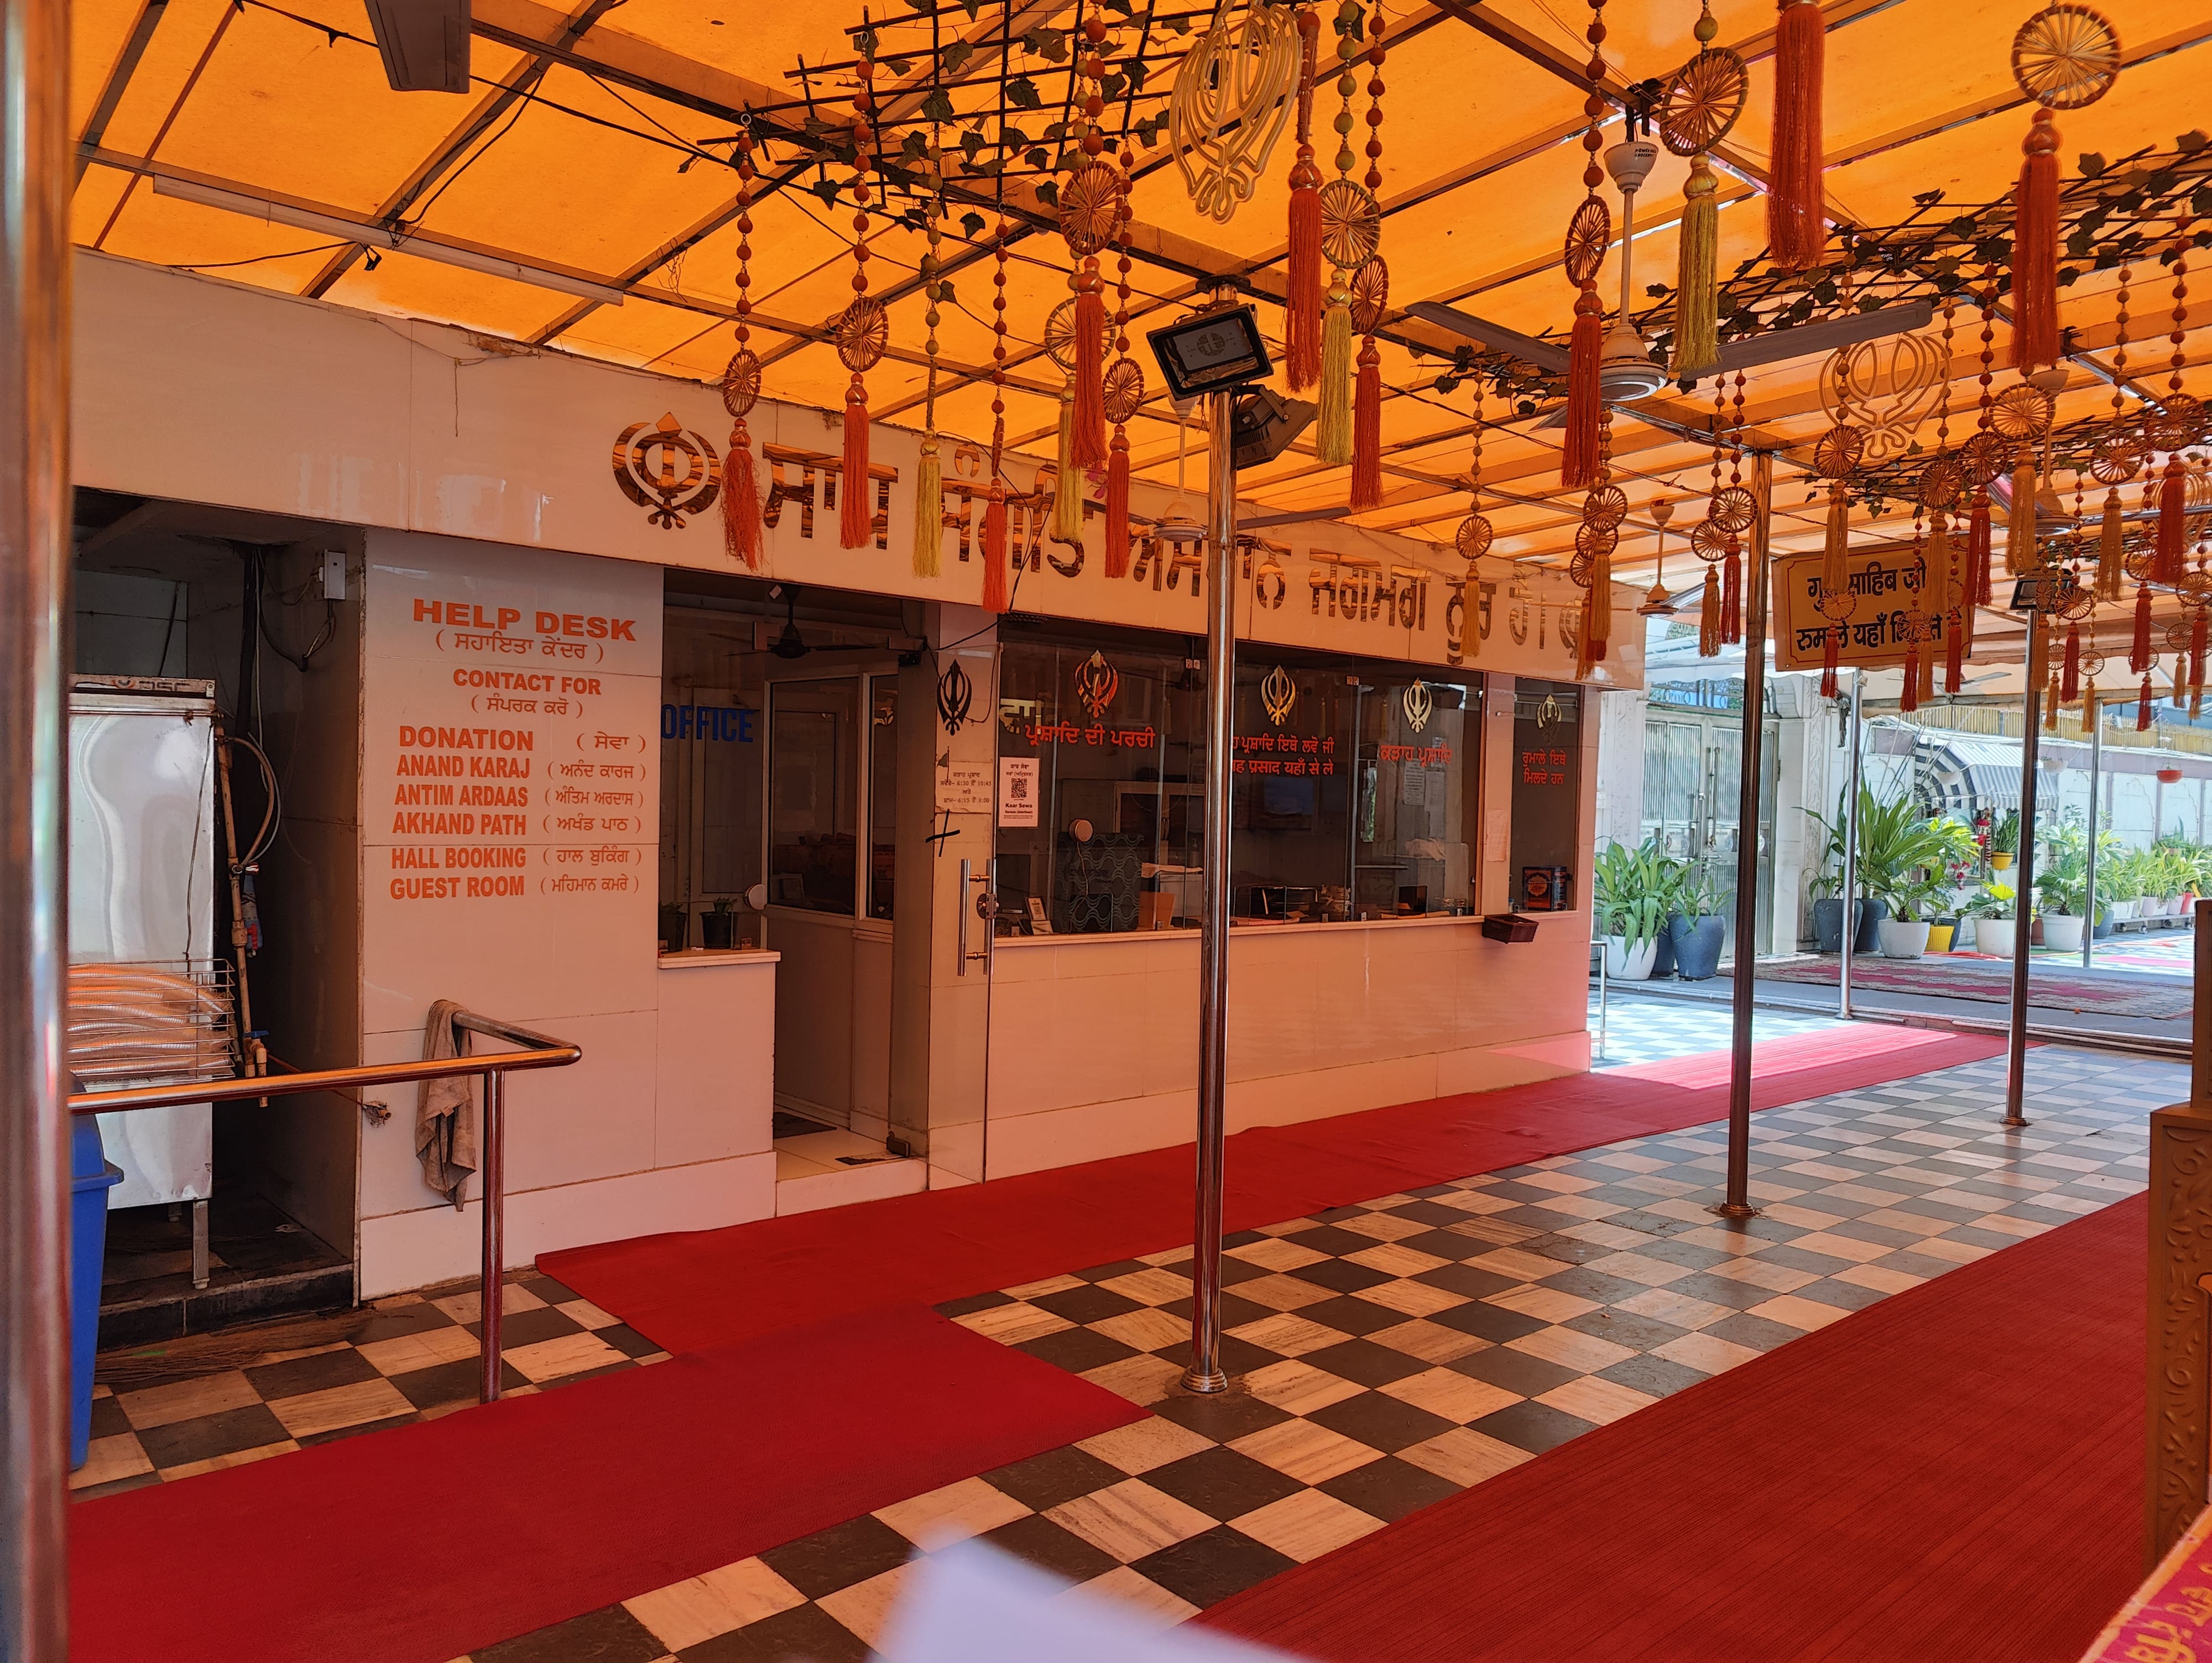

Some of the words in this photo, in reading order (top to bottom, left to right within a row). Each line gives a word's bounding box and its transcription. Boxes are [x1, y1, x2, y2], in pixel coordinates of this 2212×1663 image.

[413, 598, 521, 630] HELP
[536, 610, 637, 641] DESK
[1853, 612, 1888, 648] यहाँ
[454, 631, 534, 654] ਸਹਾਇਤਾ
[541, 635, 588, 659] ਕੇਂਦਰ
[453, 668, 555, 692] CONTACT
[561, 677, 602, 695] FOR
[487, 693, 538, 713] ਸੰਪਰਕ
[544, 696, 569, 715] ਕਰੋ
[661, 703, 754, 743] OFFICE
[1025, 720, 1080, 746] ਪ੍ਰਸ਼ਾਦਿ
[1084, 723, 1106, 745] ਦੀ
[1110, 726, 1156, 748] ਪਰਚੀ
[399, 725, 534, 751] DONATION
[594, 731, 630, 749] ਸੇਵਾ
[1322, 736, 1334, 754] ਜੀ
[1380, 745, 1415, 762] ਕੜਾਹ
[1522, 748, 1547, 767] ਰੁਮਾਲੇ
[396, 754, 464, 777] ANAND
[470, 756, 530, 778] KARAJ
[560, 759, 594, 777] ਅਨੰਦ
[599, 765, 635, 778] ਕਾਰਜ
[1249, 760, 1281, 775] प्रसाद
[1284, 757, 1306, 775] यहाँ
[1308, 757, 1320, 775] से
[1323, 758, 1334, 775] ले
[1524, 767, 1548, 783] ਮਿਲਦੇ
[1551, 773, 1564, 785] ਹਨ
[394, 783, 453, 806] ANTIM
[458, 785, 528, 807] ARDAAS
[555, 786, 590, 804] ਅੰਤਿਮ
[594, 792, 634, 806] ਅਰਦਾਸ
[392, 812, 474, 835] AKHAND
[481, 814, 526, 835] PATH
[557, 813, 596, 831] ਅਖੰਡ
[602, 818, 629, 831] ਪਾਠ
[392, 848, 440, 869] HALL
[445, 847, 526, 869] BOOKING
[556, 850, 585, 862] ਹਾਲ
[589, 845, 630, 866] ਬੁਕਿੰਗ
[390, 877, 461, 900] GUEST
[467, 875, 524, 897] ROOM
[551, 874, 597, 892] ਮਹਿਮਾਨ
[601, 874, 629, 891] ਕਮਰੇ
